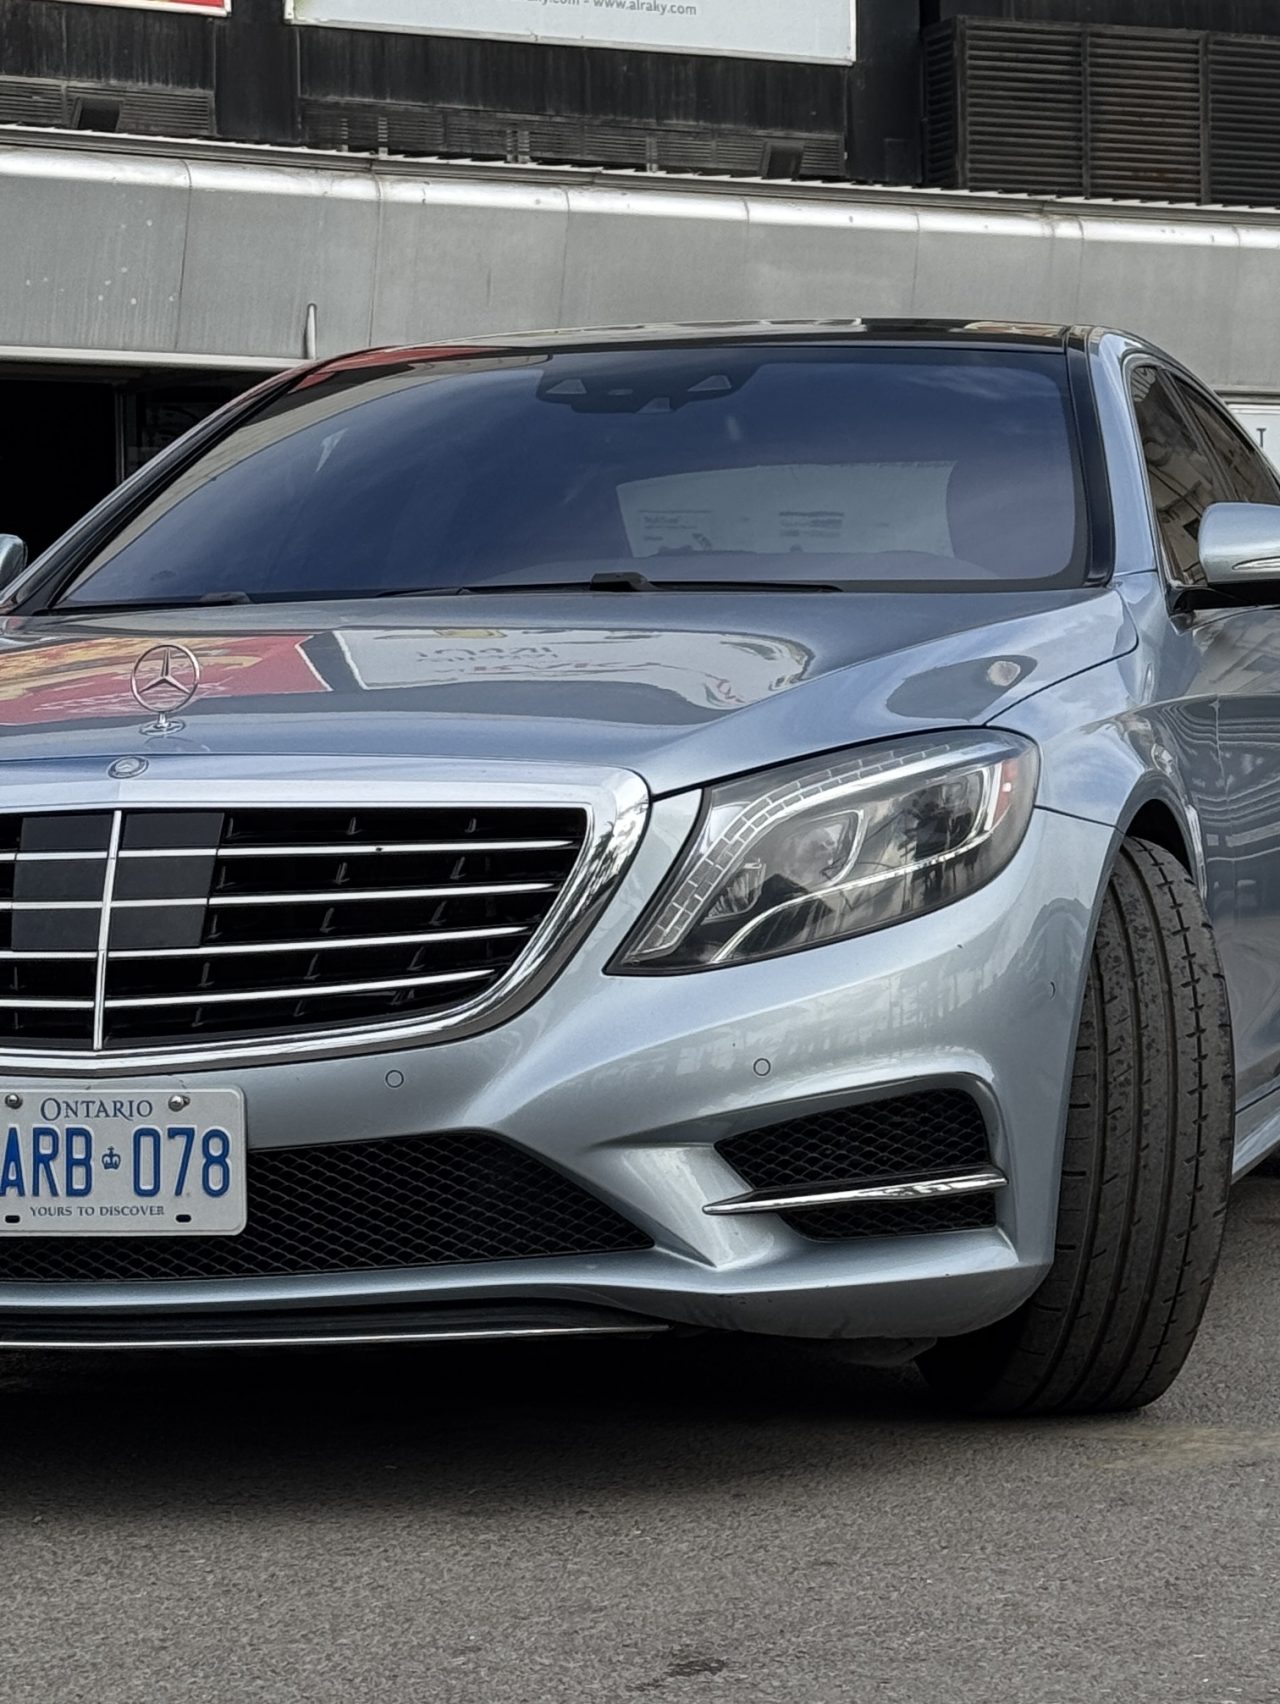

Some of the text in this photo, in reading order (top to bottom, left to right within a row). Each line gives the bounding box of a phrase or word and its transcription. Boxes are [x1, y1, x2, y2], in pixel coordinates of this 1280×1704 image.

[593, 0, 697, 15] www.alraky.com
[0, 1127, 230, 1197] ARB 078
[30, 1205, 165, 1217] YOURS TO DISCOVER
